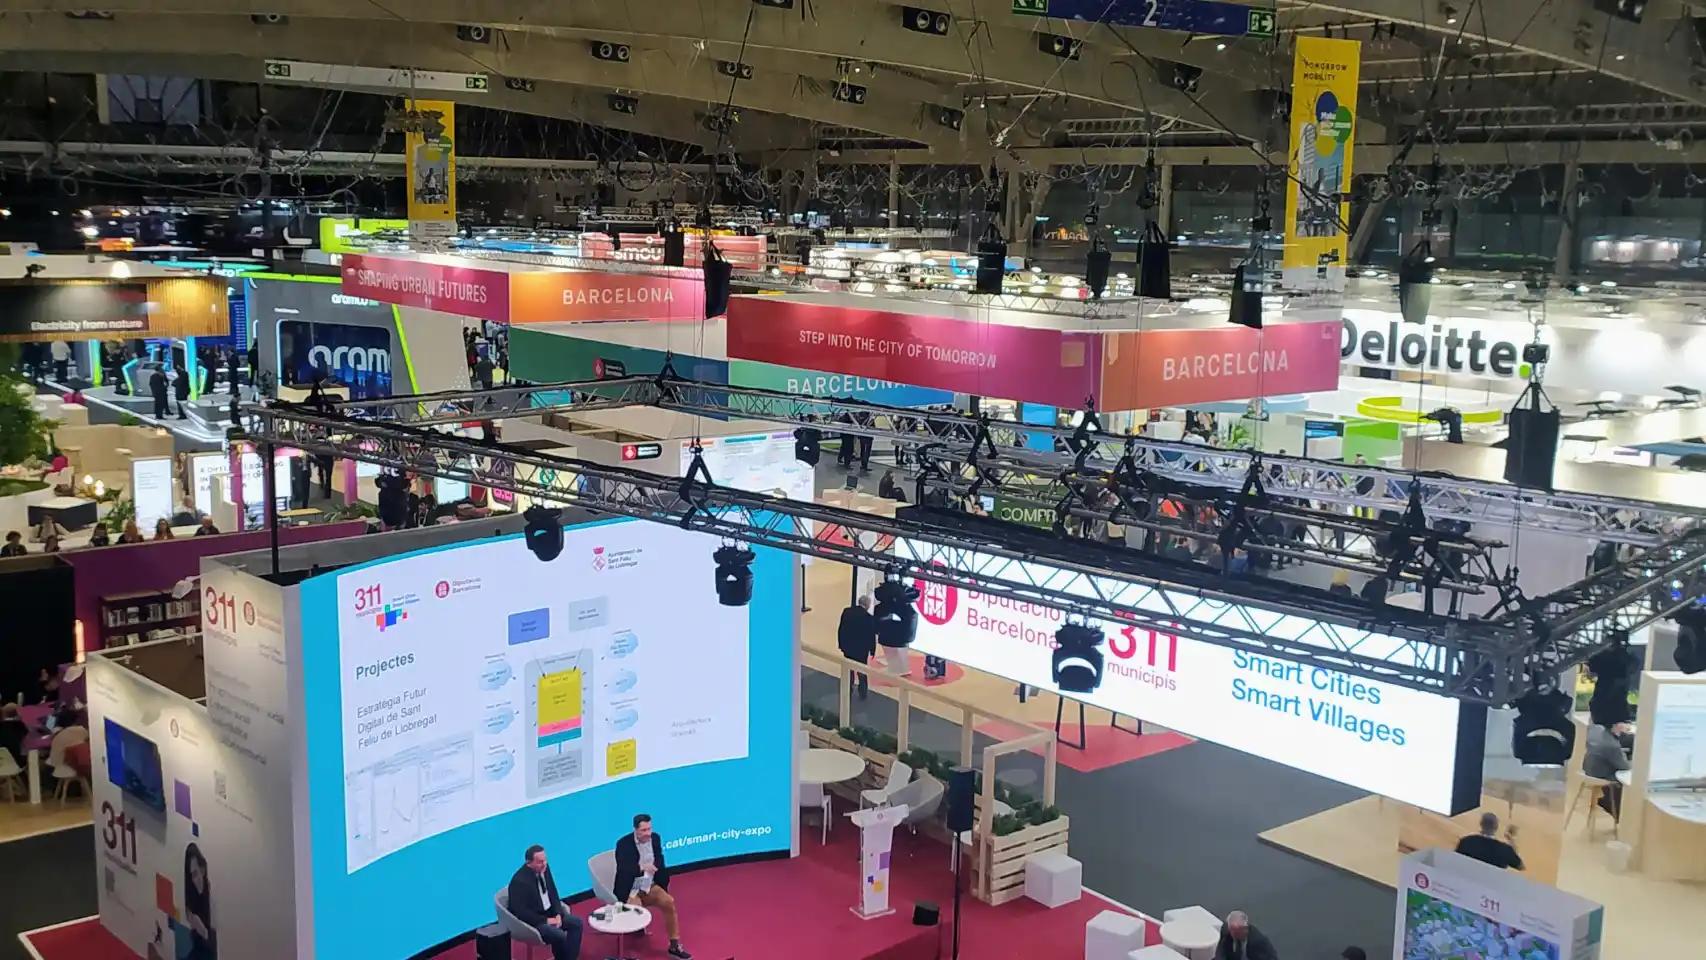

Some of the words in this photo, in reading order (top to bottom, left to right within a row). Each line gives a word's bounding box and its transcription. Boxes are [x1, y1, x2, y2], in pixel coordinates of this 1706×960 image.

[1144, 0, 1157, 26] 2
[358, 269, 400, 292] SHAPING
[401, 275, 436, 297] URBAN
[438, 279, 487, 304] FUTURES
[562, 287, 675, 305] BARCELONA
[82, 320, 107, 330] from
[108, 319, 144, 329] nature
[799, 330, 824, 345] STEP
[828, 333, 852, 349] INTO
[855, 336, 875, 352] THE
[879, 339, 904, 356] CITY
[907, 343, 922, 358] OF
[925, 345, 997, 369] TOMORROW
[1163, 348, 1288, 381] BARCELONA
[205, 586, 237, 634] 311
[355, 583, 382, 611] 311
[966, 607, 1061, 651] Barcelona
[1108, 609, 1178, 673] 311
[356, 652, 415, 681] Projectes
[1107, 661, 1177, 691] municipis
[1233, 649, 1303, 685] Smart
[1310, 666, 1381, 705] Cities
[403, 687, 427, 702] Futur
[357, 715, 385, 735] Digital
[386, 712, 398, 723] de
[400, 703, 421, 718] Sant
[380, 729, 393, 741] de
[394, 713, 437, 736] Llobregat
[1231, 677, 1301, 717] Smart
[1308, 697, 1406, 746] Villages
[101, 800, 137, 866] 311
[1479, 895, 1500, 913] 311
